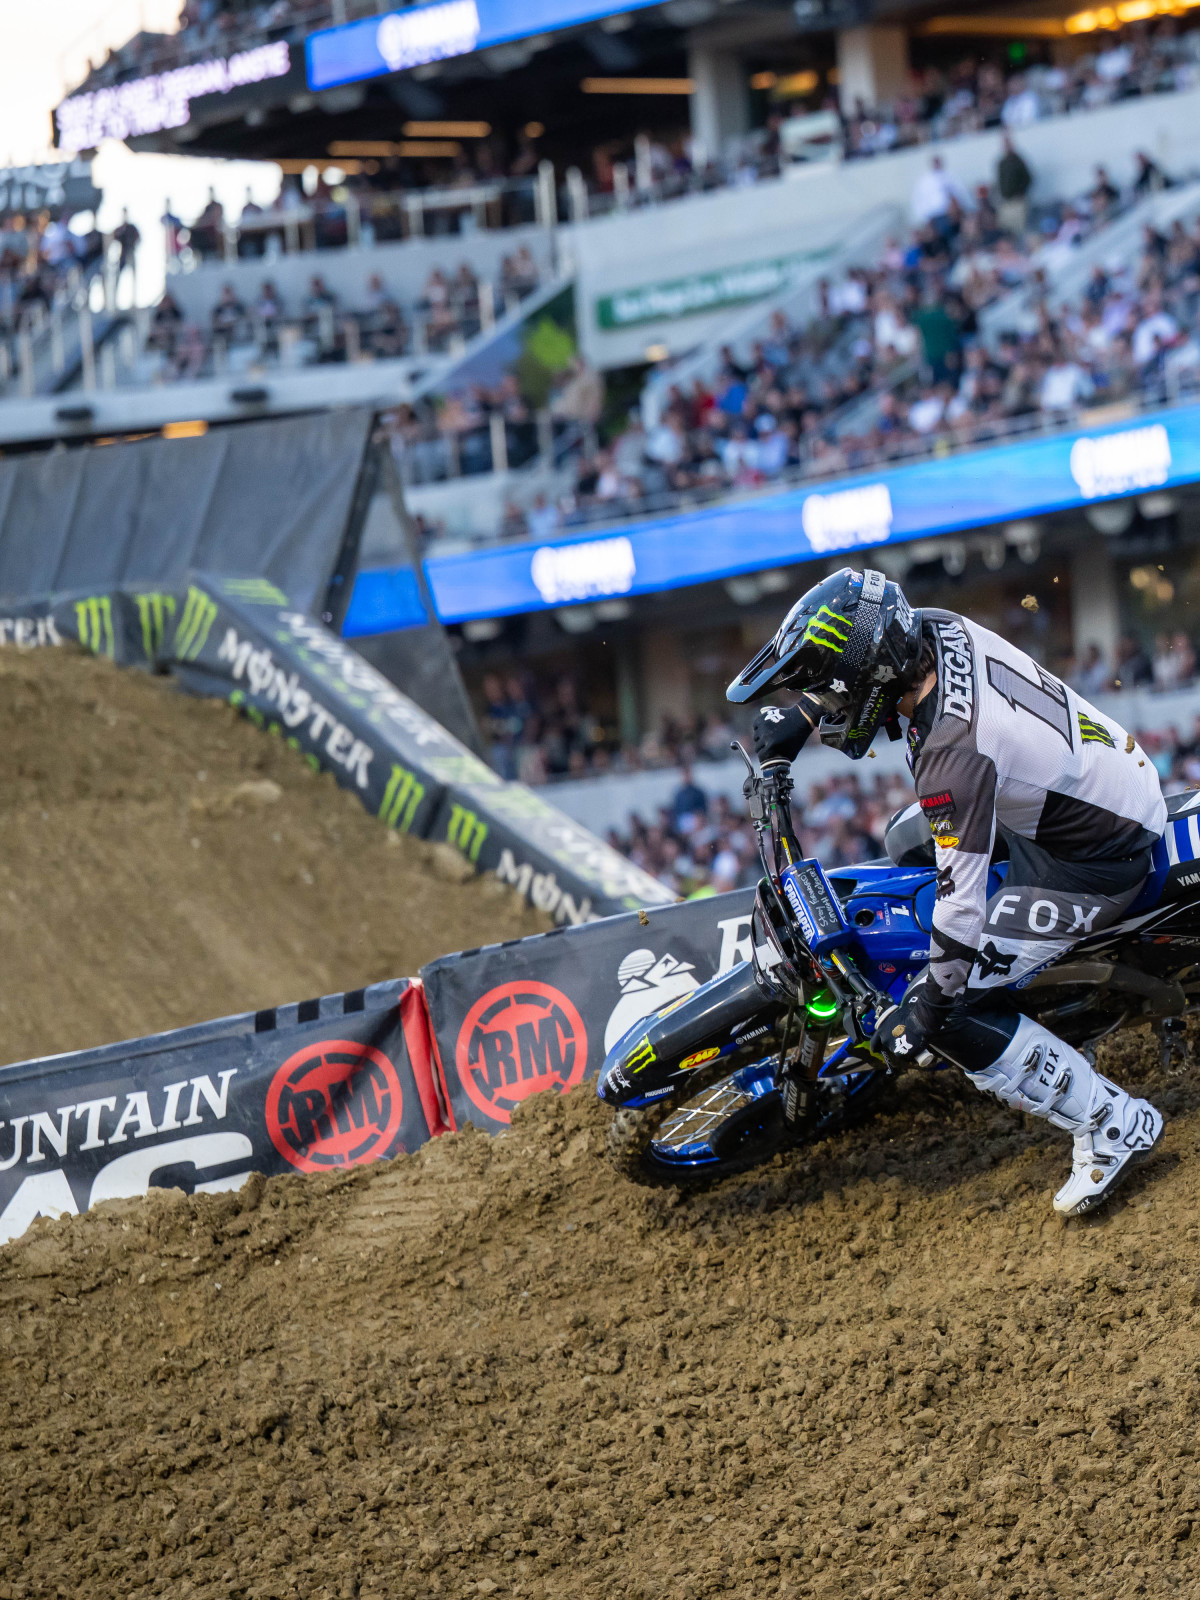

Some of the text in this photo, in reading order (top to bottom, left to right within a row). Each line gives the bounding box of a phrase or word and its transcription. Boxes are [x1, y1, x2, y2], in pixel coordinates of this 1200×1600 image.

[938, 621, 973, 725] DEEGAN
[985, 655, 1074, 754] 1
[785, 884, 813, 941] PROTAPER
[989, 895, 1101, 932] FOX
[742, 1025, 769, 1042] YAMAHA
[679, 1047, 721, 1070] FMF
[1039, 1048, 1060, 1087] FOX
[645, 1085, 675, 1098] PROGRESSIVE
[1077, 1198, 1091, 1213] FOX
